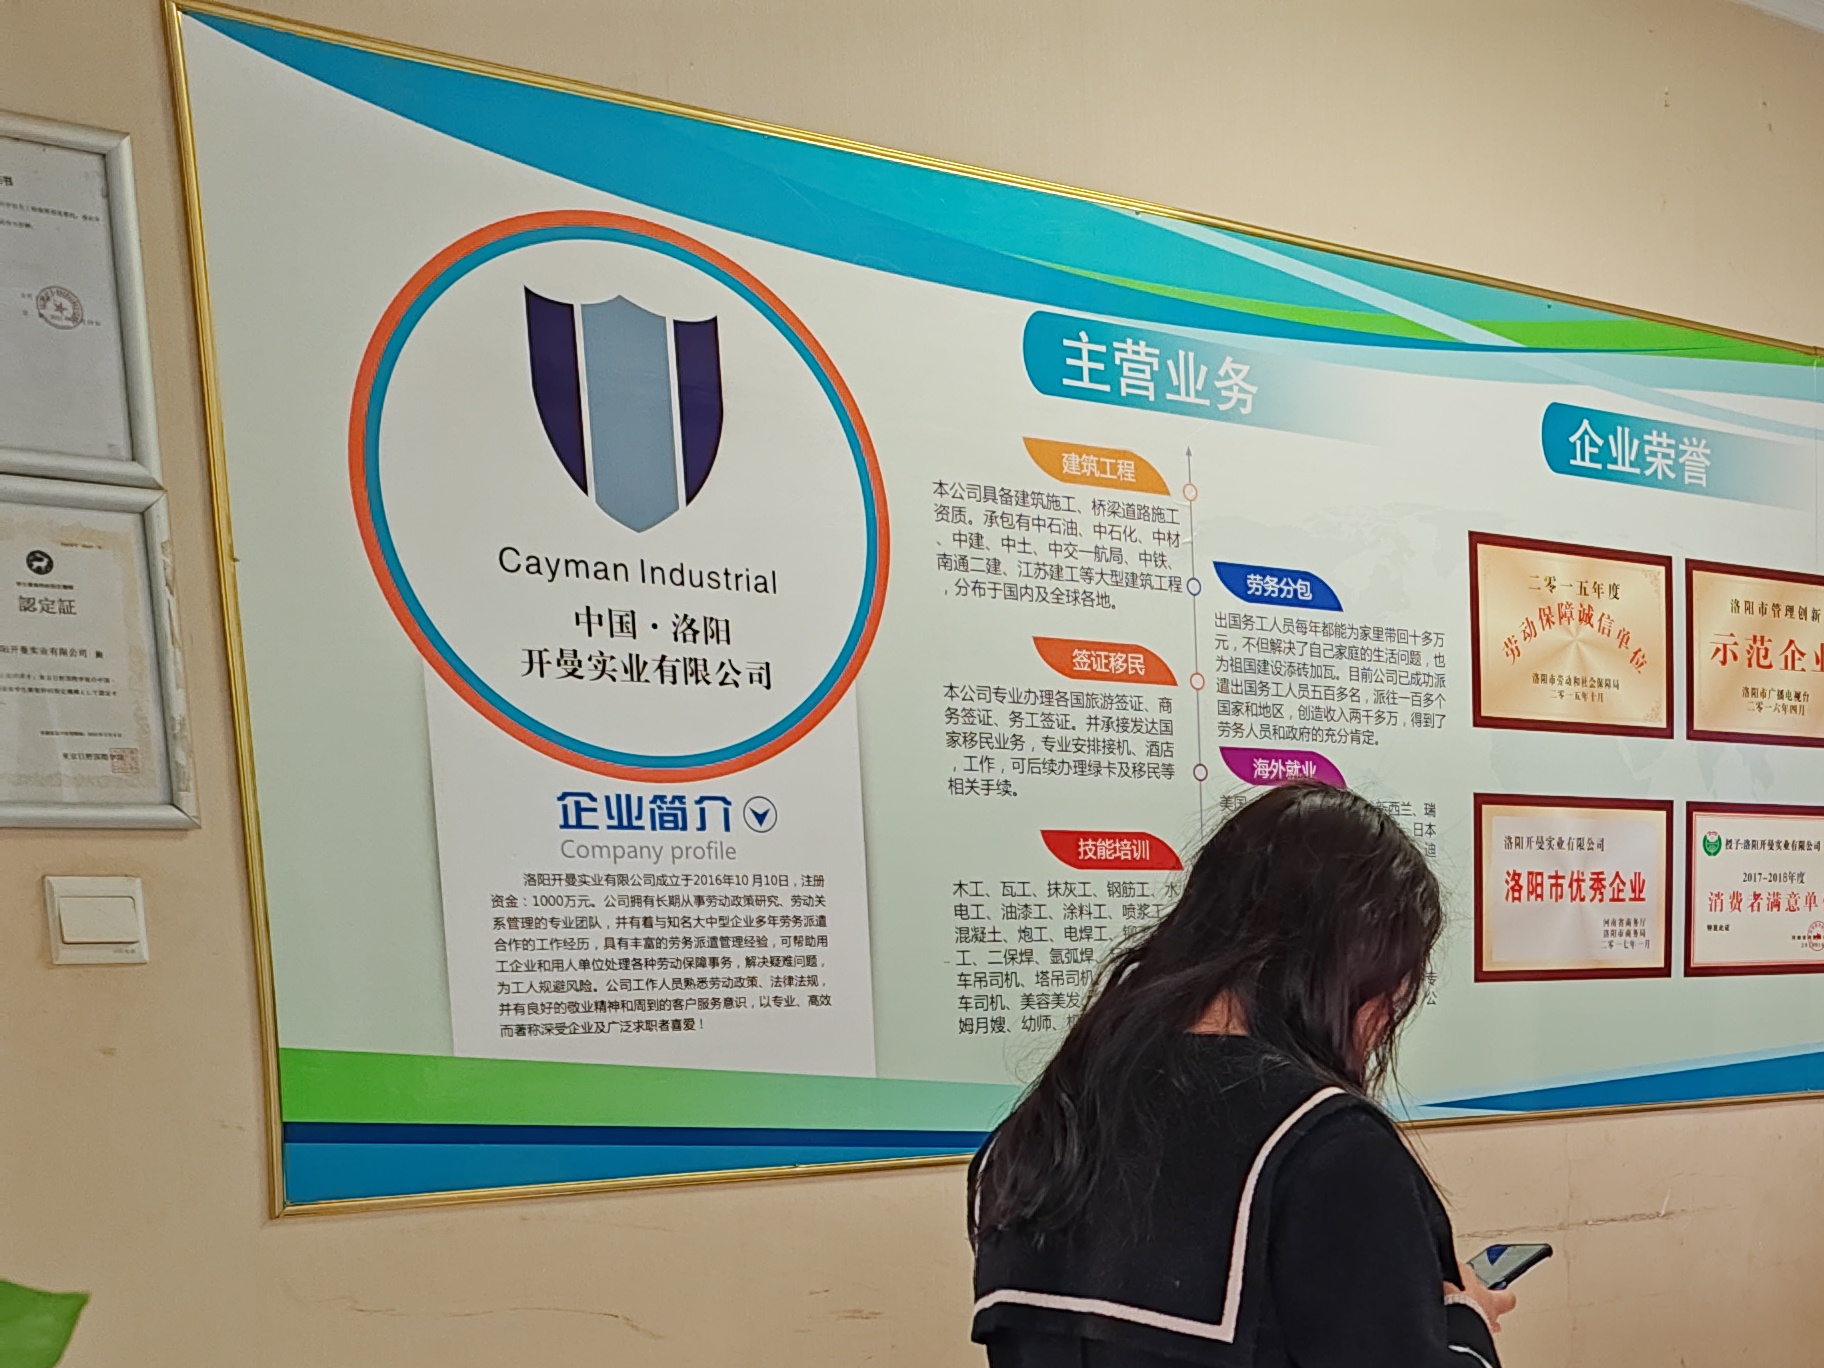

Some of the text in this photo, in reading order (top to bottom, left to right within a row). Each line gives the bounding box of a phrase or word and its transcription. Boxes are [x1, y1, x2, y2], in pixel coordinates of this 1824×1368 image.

[1062, 331, 1258, 415] 主营业务
[1062, 452, 1136, 482] 建筑工程
[1569, 418, 1712, 487] 企业荣誉
[932, 480, 1181, 525] 本公司具备建筑施工、桥梁道路施工
[933, 503, 1181, 548] 资质。承包有中石油、中石化、中材
[498, 546, 778, 594] Cayman Industrial
[937, 553, 1183, 593] 南通二建、江苏建工等大型建筑工程
[1246, 574, 1313, 602] 劳务分包
[1528, 575, 1620, 600] 二零一五年度
[1730, 599, 1821, 623] 洛阳市管理创新
[1215, 611, 1445, 648] 出国务工人员每年都能为家里带回十多万
[1503, 601, 1647, 674] 劳动保障诚信单位
[521, 647, 773, 691] 开曼实业有限公司
[1072, 648, 1146, 676] 签证移民
[943, 682, 1172, 714] 本公司专业办理各国旅游签证、商
[945, 707, 1174, 736] 务签证、务工签证。并承接发达国
[1218, 721, 1380, 746] 劳务人员和政府的充分肯定。
[946, 731, 1175, 758] 家移民业务，专业安排接机、酒店
[1253, 758, 1317, 780] 海外就业
[948, 777, 1018, 798] 相关手续。
[557, 791, 732, 833] 企业简介
[560, 840, 737, 865] Company profile
[1078, 838, 1150, 862] 技能培训
[1504, 835, 1605, 852] 洛阳开曼实业有限公司
[1504, 869, 1646, 903] 洛阳市优秀企业
